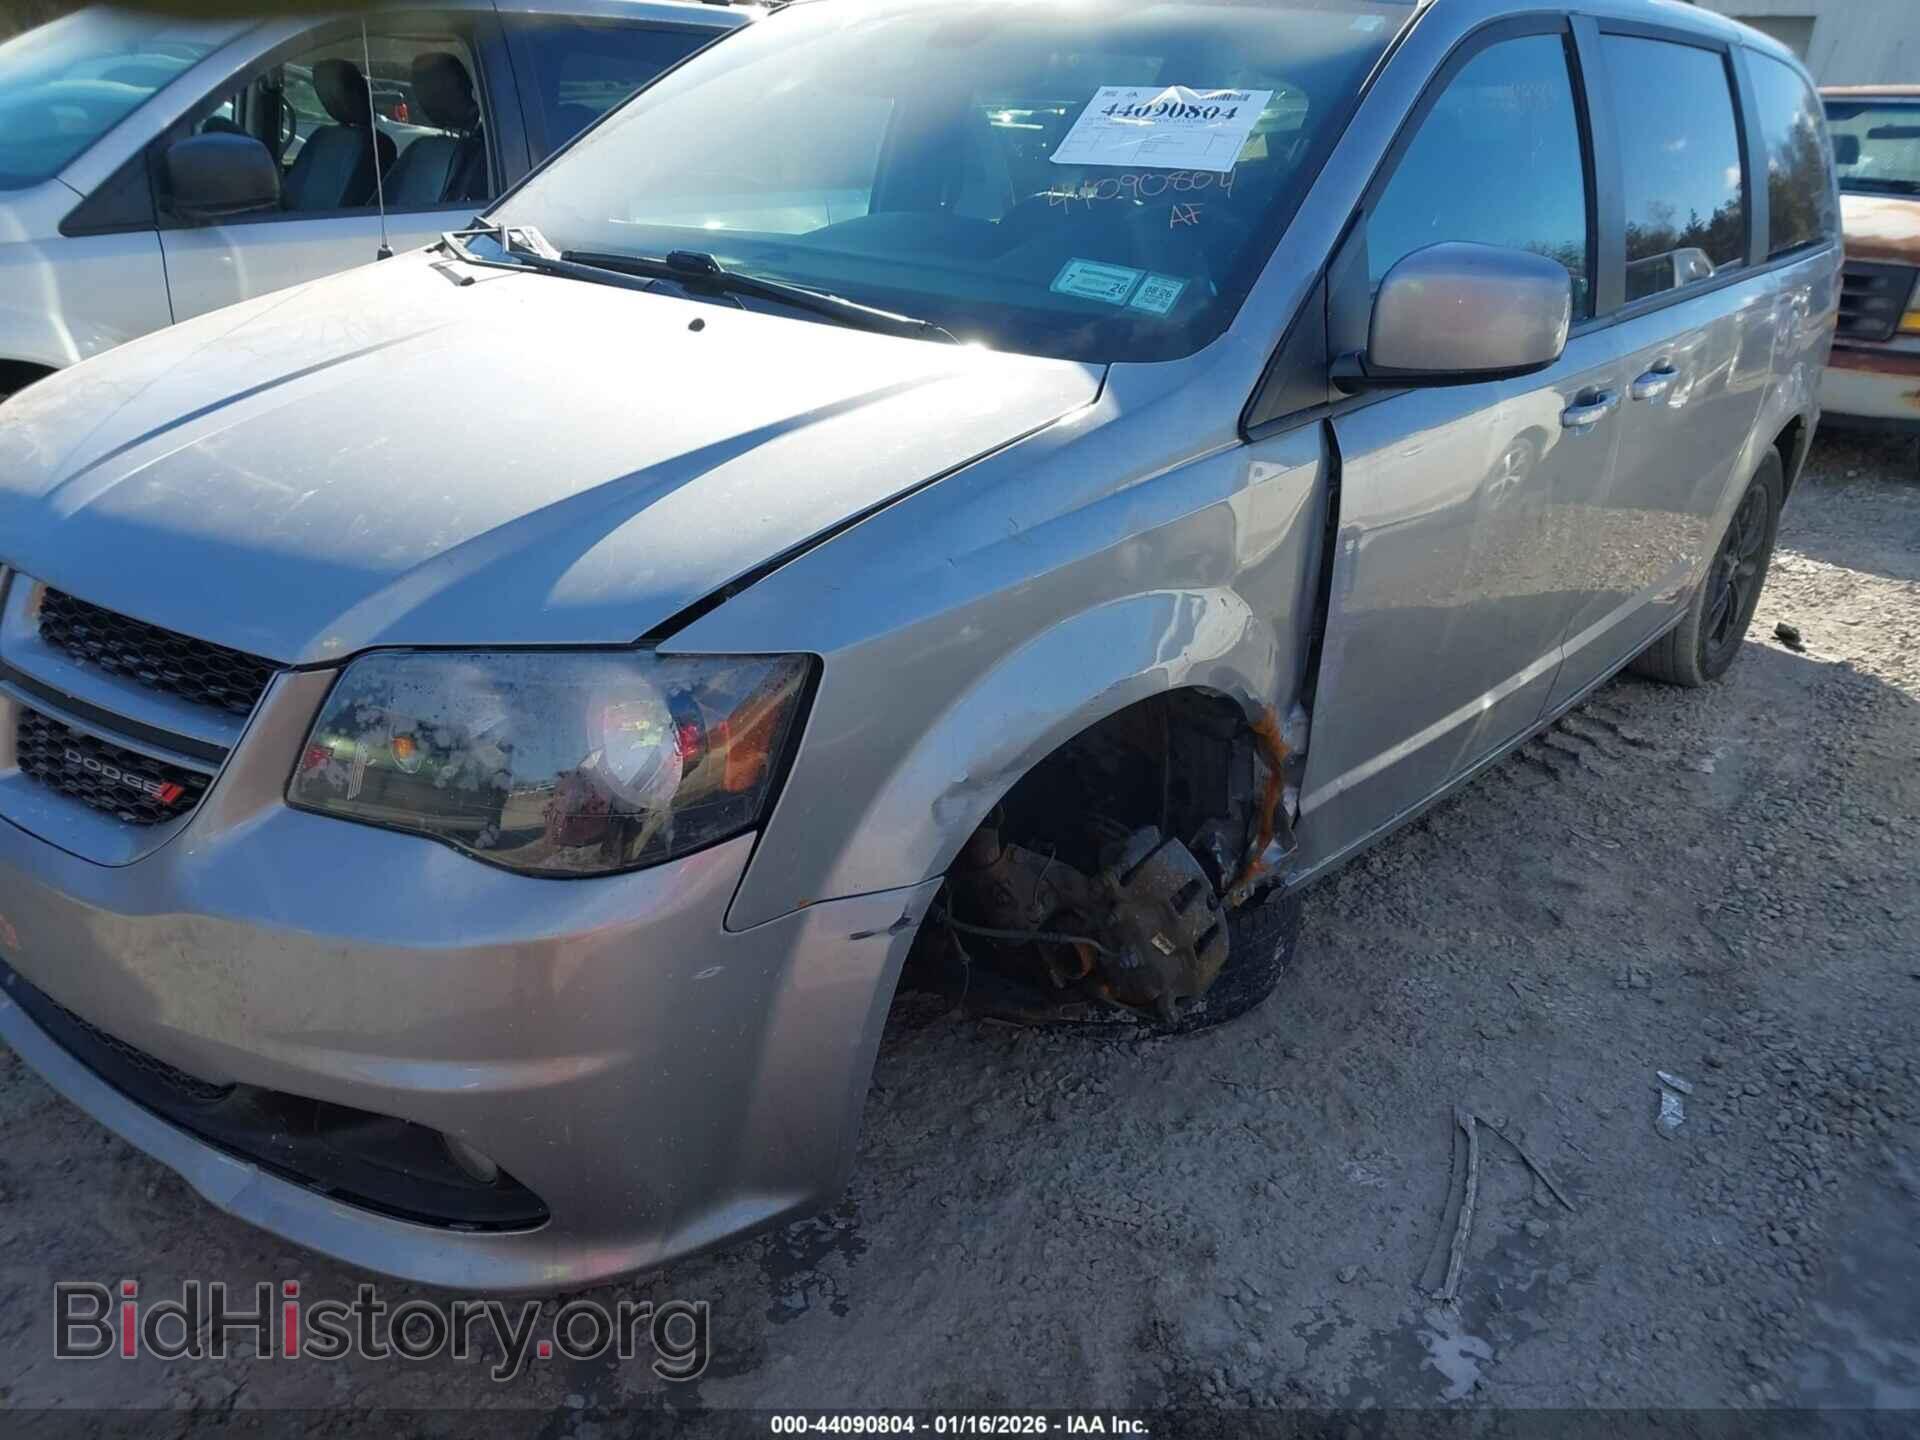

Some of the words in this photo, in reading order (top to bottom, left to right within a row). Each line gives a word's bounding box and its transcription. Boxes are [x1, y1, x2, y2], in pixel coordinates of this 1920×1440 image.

[1100, 102, 1240, 121] 44090804
[1109, 283, 1128, 294] 26
[63, 747, 164, 798] DODGE
